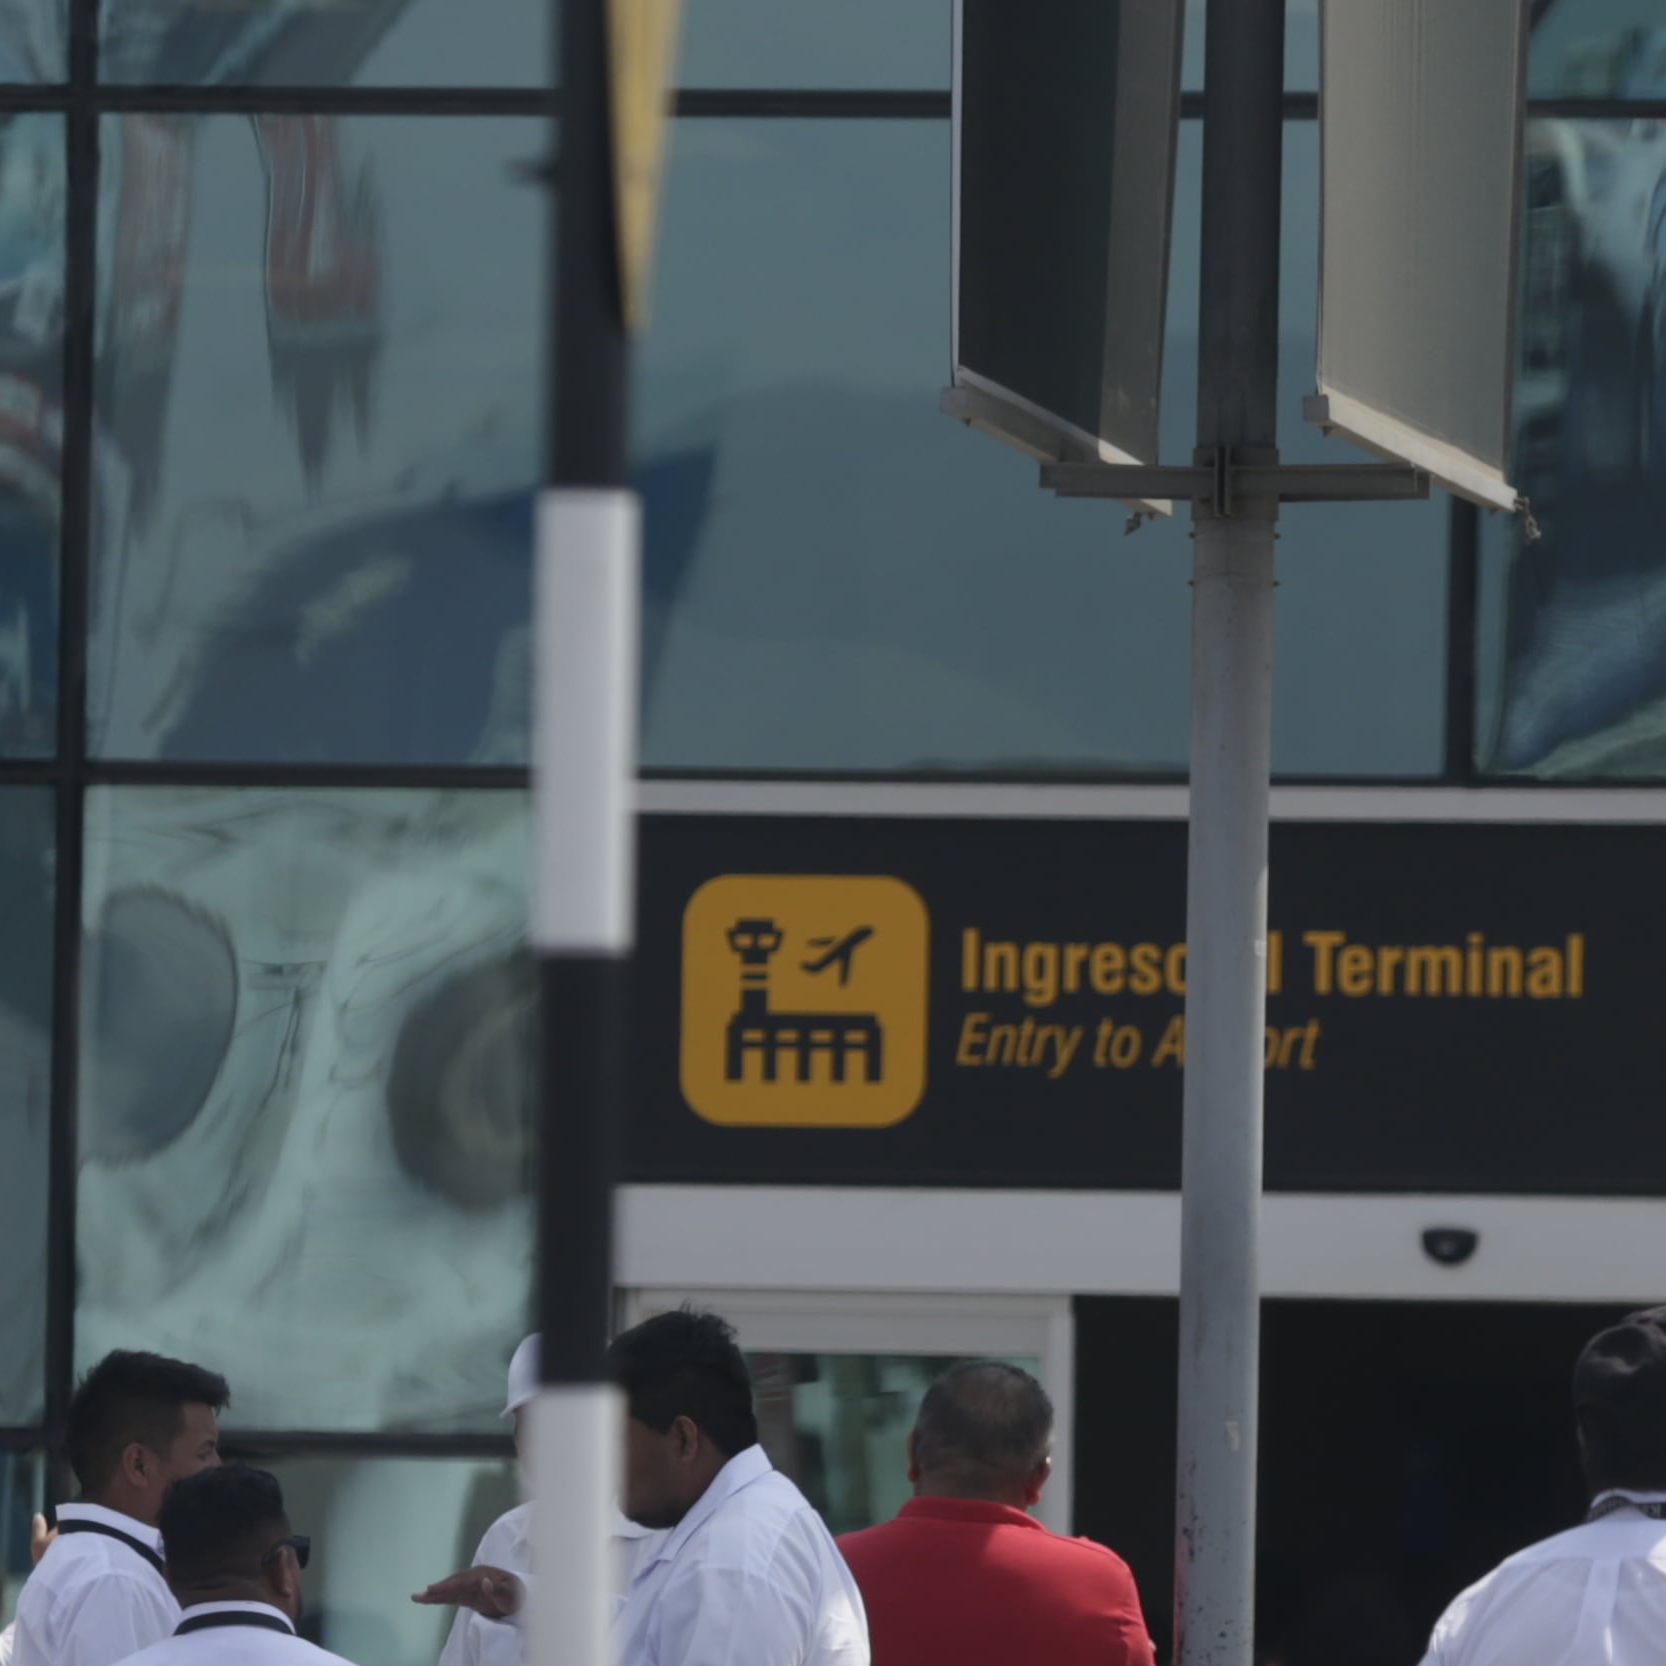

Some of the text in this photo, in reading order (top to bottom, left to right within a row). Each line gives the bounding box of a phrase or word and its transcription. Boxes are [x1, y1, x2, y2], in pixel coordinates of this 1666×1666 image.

[1303, 930, 1585, 999] Terminal
[956, 1013, 1082, 1077] Entry
[1094, 1018, 1141, 1067] to
